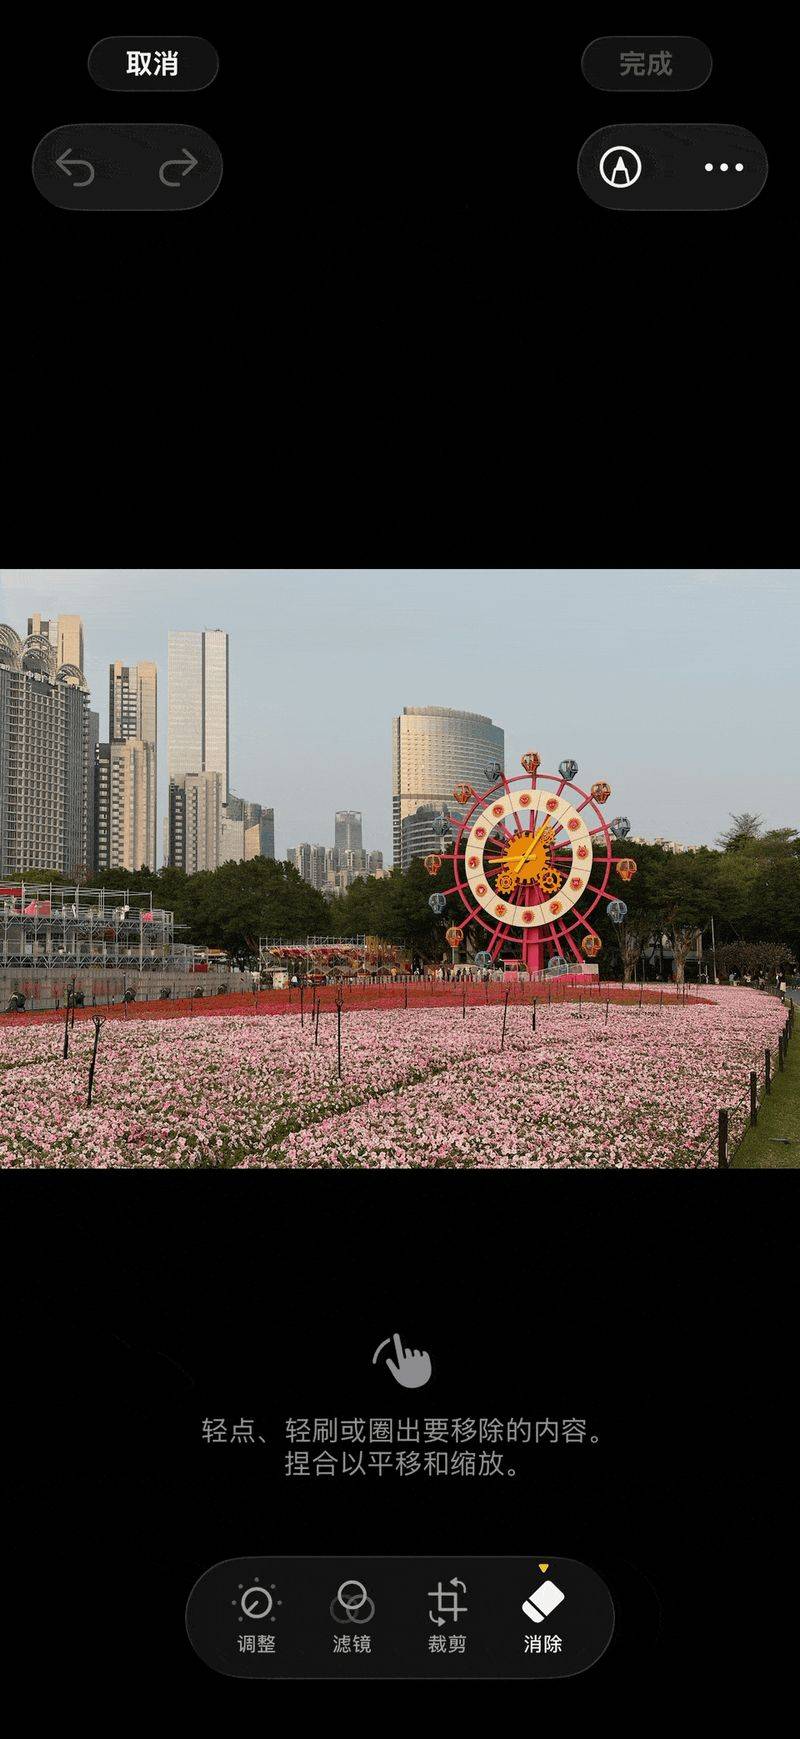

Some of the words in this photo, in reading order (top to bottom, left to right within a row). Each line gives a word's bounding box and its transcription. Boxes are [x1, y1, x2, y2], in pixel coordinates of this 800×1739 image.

[126, 50, 178, 76] 取消
[620, 50, 672, 77] 完成
[202, 1417, 600, 1444] 轻点、轻刷或圈出要移除的内容。
[284, 1450, 518, 1477] 捏合以平移和缩放。
[237, 1634, 276, 1654] 调整
[333, 1634, 371, 1654] 滤镜
[428, 1634, 466, 1654] 裁剪
[524, 1634, 562, 1654] 消除
